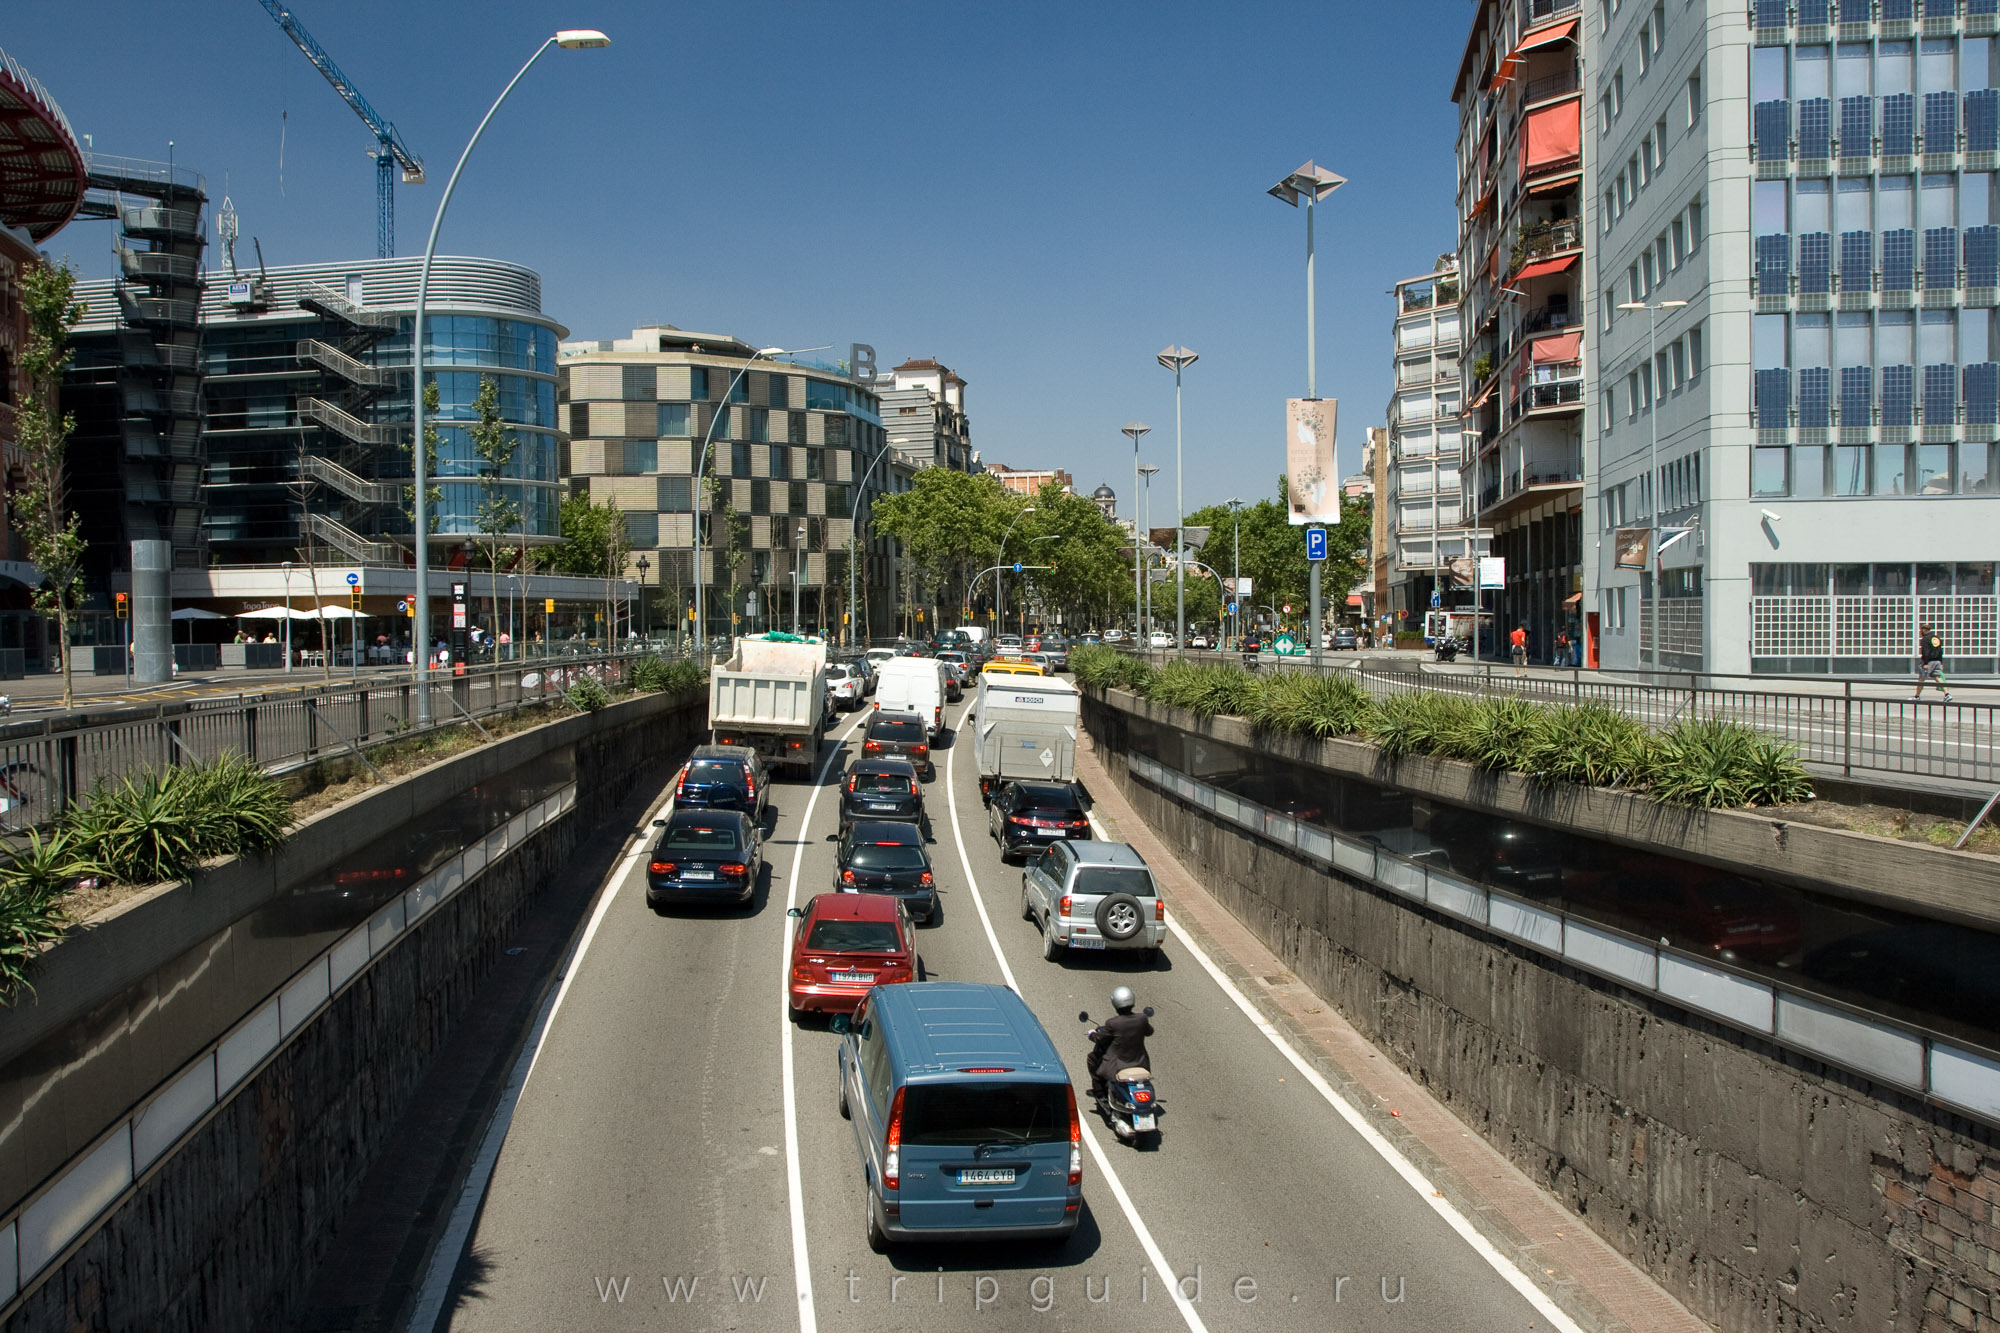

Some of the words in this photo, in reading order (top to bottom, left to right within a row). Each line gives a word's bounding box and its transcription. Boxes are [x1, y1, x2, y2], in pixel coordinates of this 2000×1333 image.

[850, 343, 877, 384] B
[1311, 534, 1322, 548] P
[965, 1170, 990, 1181] 1464
[993, 1169, 1014, 1180] CYB
